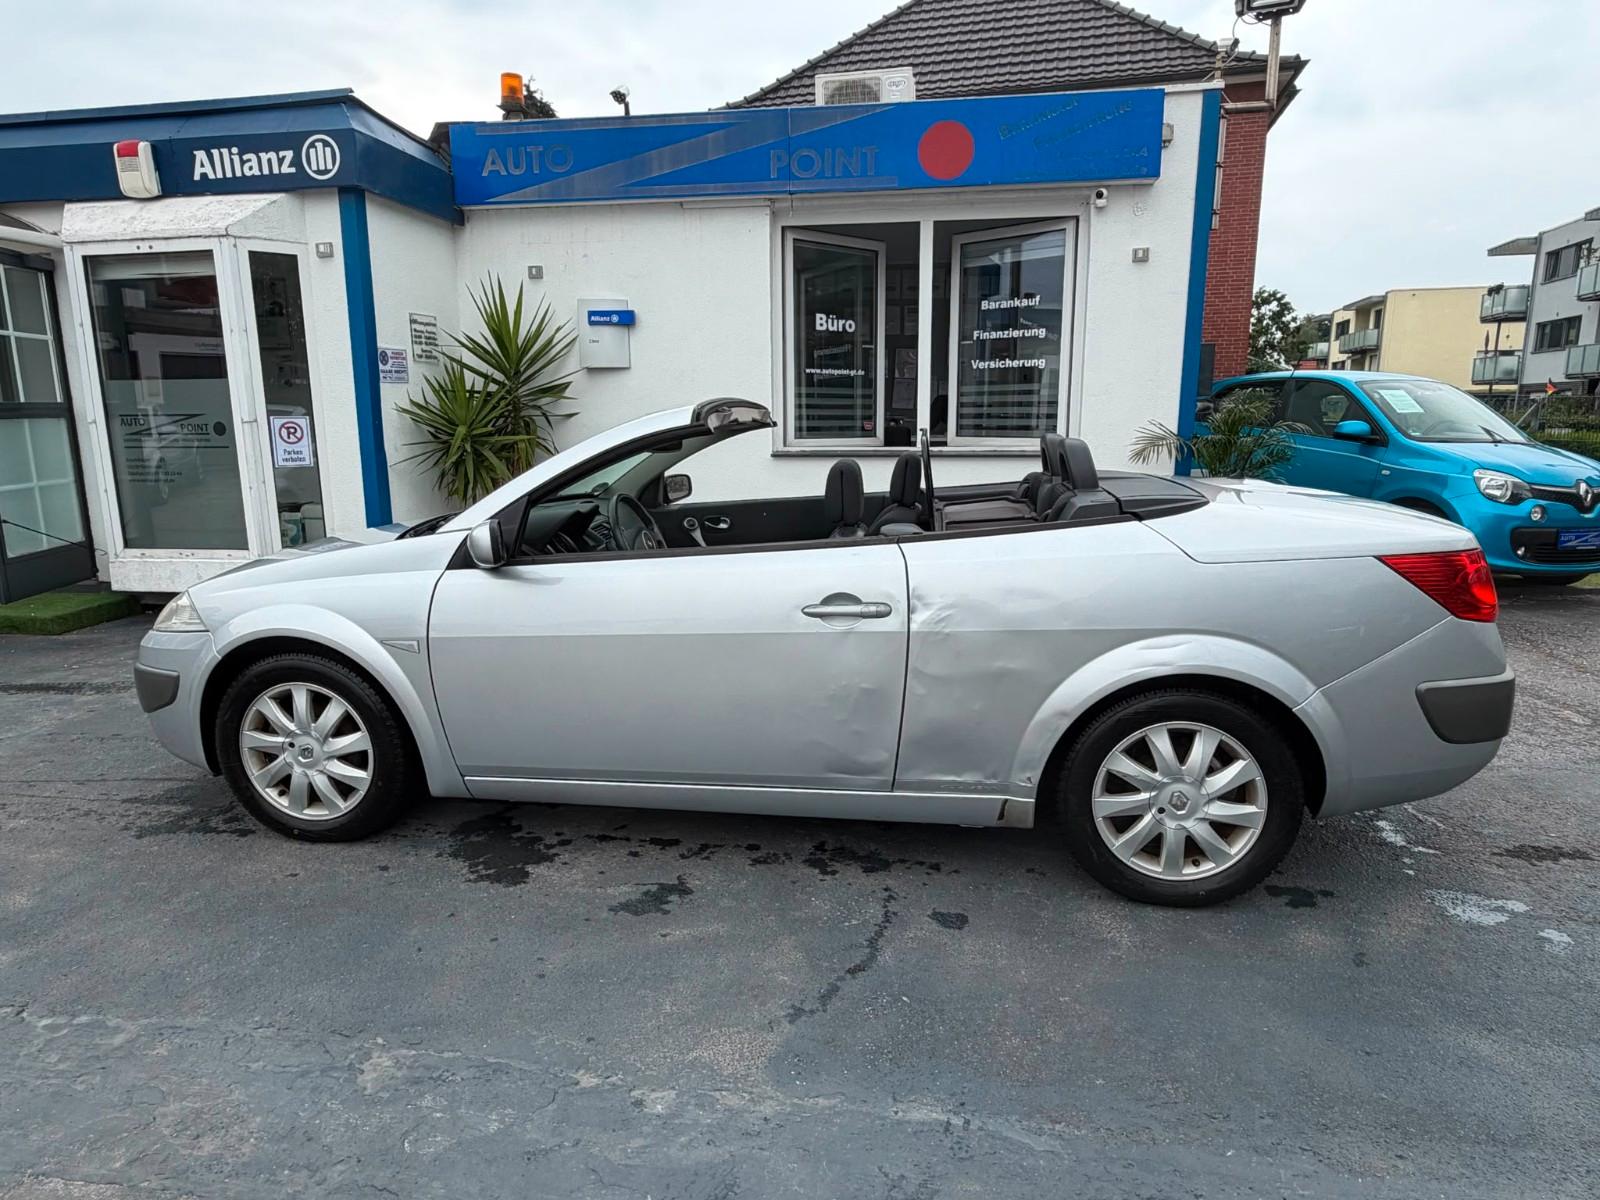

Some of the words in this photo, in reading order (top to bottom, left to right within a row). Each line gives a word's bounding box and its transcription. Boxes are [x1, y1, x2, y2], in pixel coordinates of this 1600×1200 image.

[193, 147, 296, 181] Allianz
[482, 144, 574, 177] AUTO
[770, 146, 880, 178] POINT
[981, 295, 1041, 311] Barankauf
[815, 313, 856, 333] Büro
[973, 328, 1047, 341] Finanzierung
[971, 358, 1046, 370] Versicherung
[120, 417, 145, 427] AUTO
[180, 423, 210, 432] POINT
[283, 448, 304, 456] Parken
